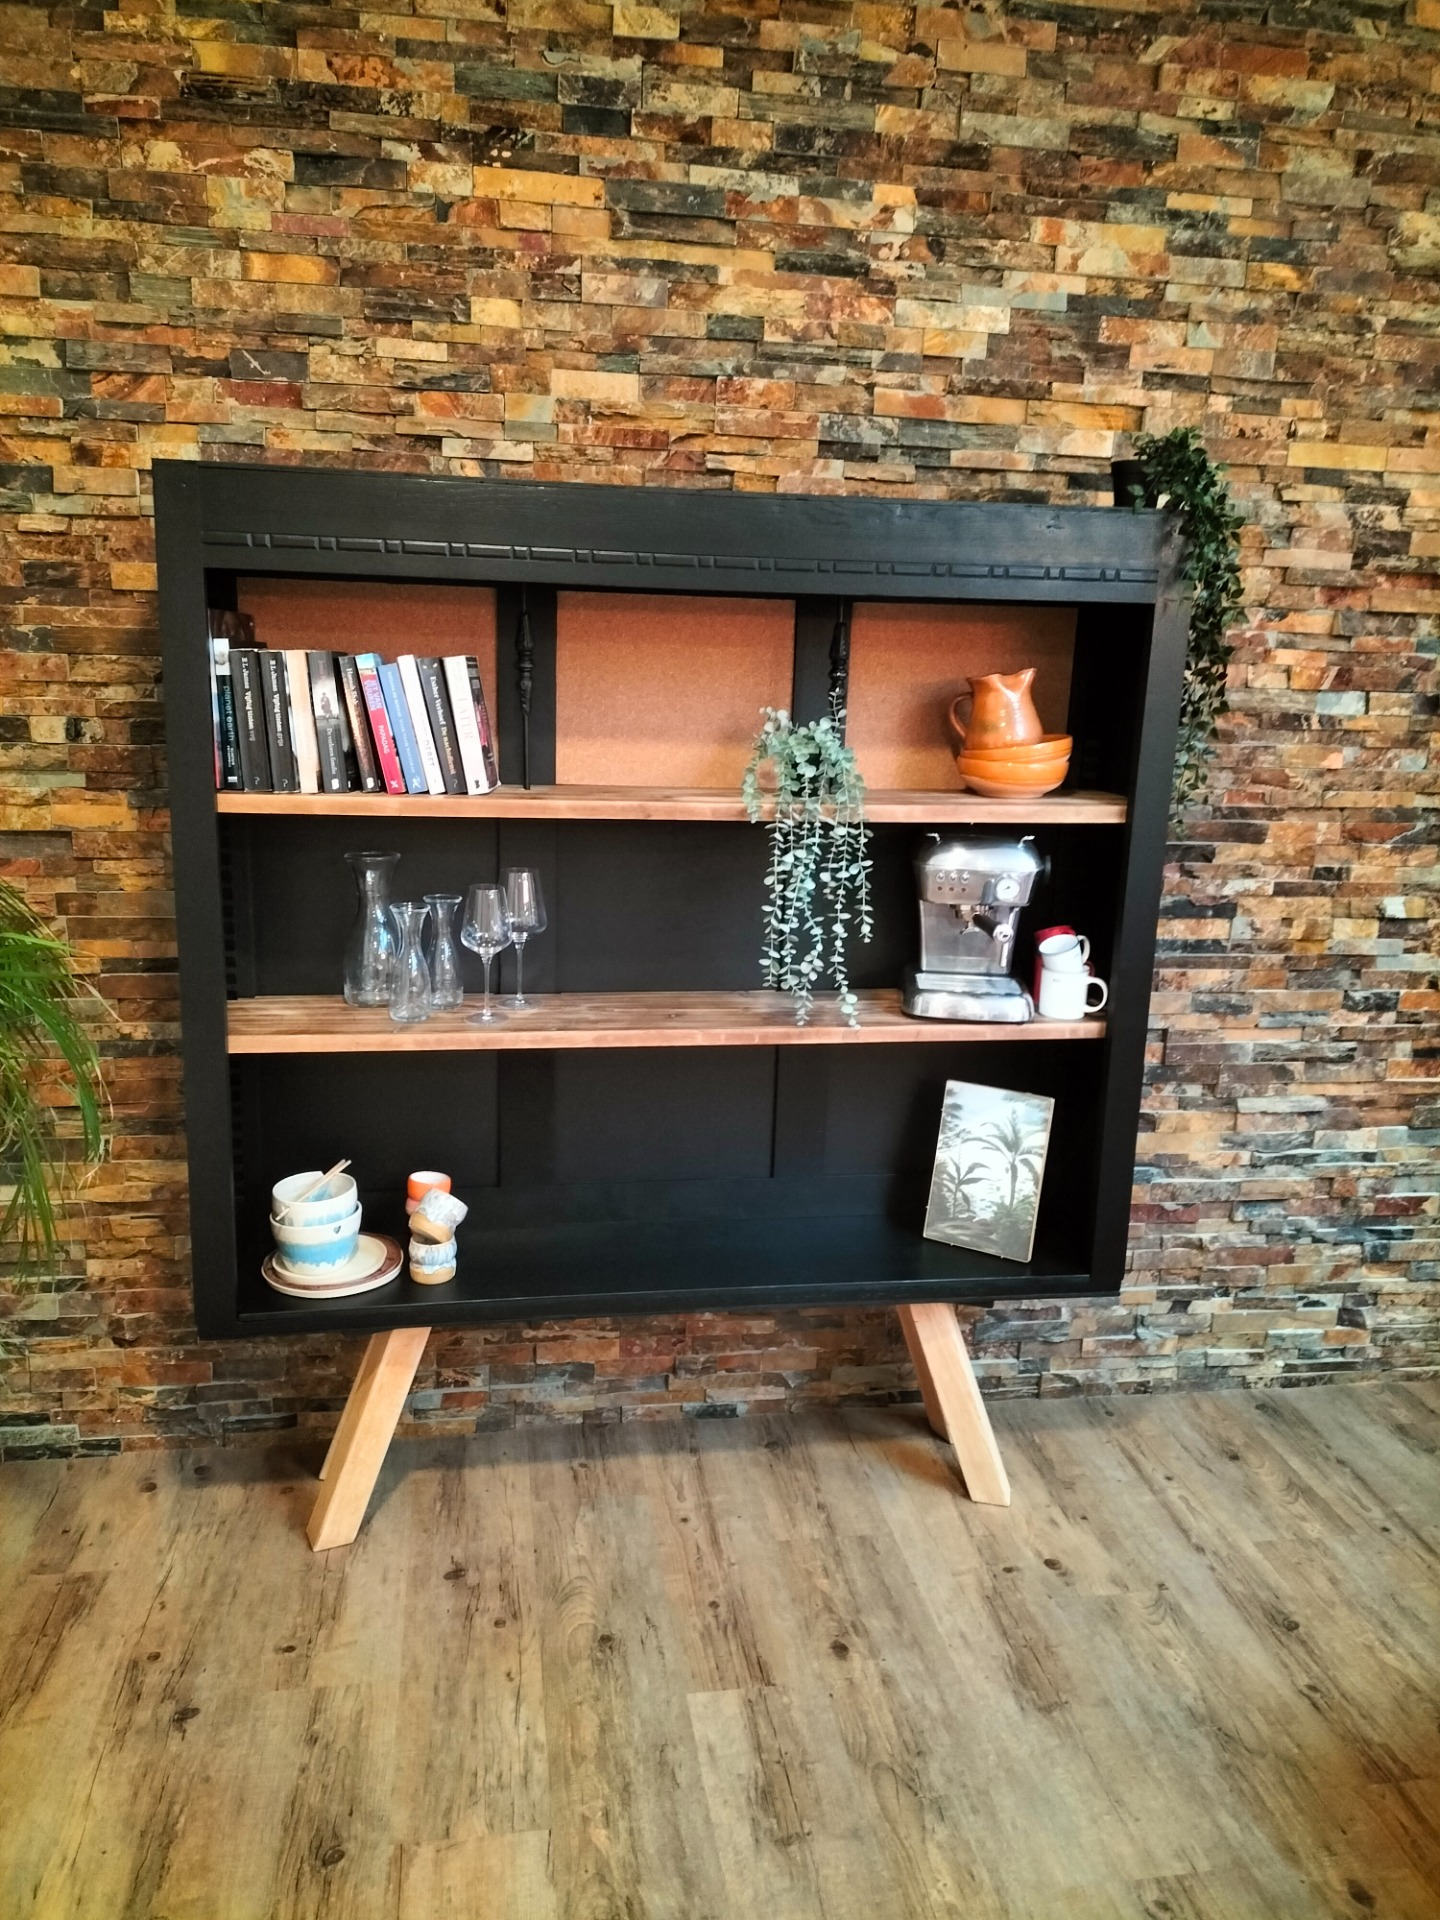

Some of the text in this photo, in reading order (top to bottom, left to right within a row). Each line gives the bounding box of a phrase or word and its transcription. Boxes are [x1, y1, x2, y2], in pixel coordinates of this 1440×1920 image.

[242, 669, 250, 689] James
[223, 686, 233, 714] planet
[363, 680, 376, 711] VUUREN
[372, 691, 382, 709] VAN
[226, 716, 234, 741] earth
[326, 728, 332, 736] De
[429, 676, 456, 775] Esther Verhoef De nachtdienst
[377, 725, 390, 754] PAPADAG
